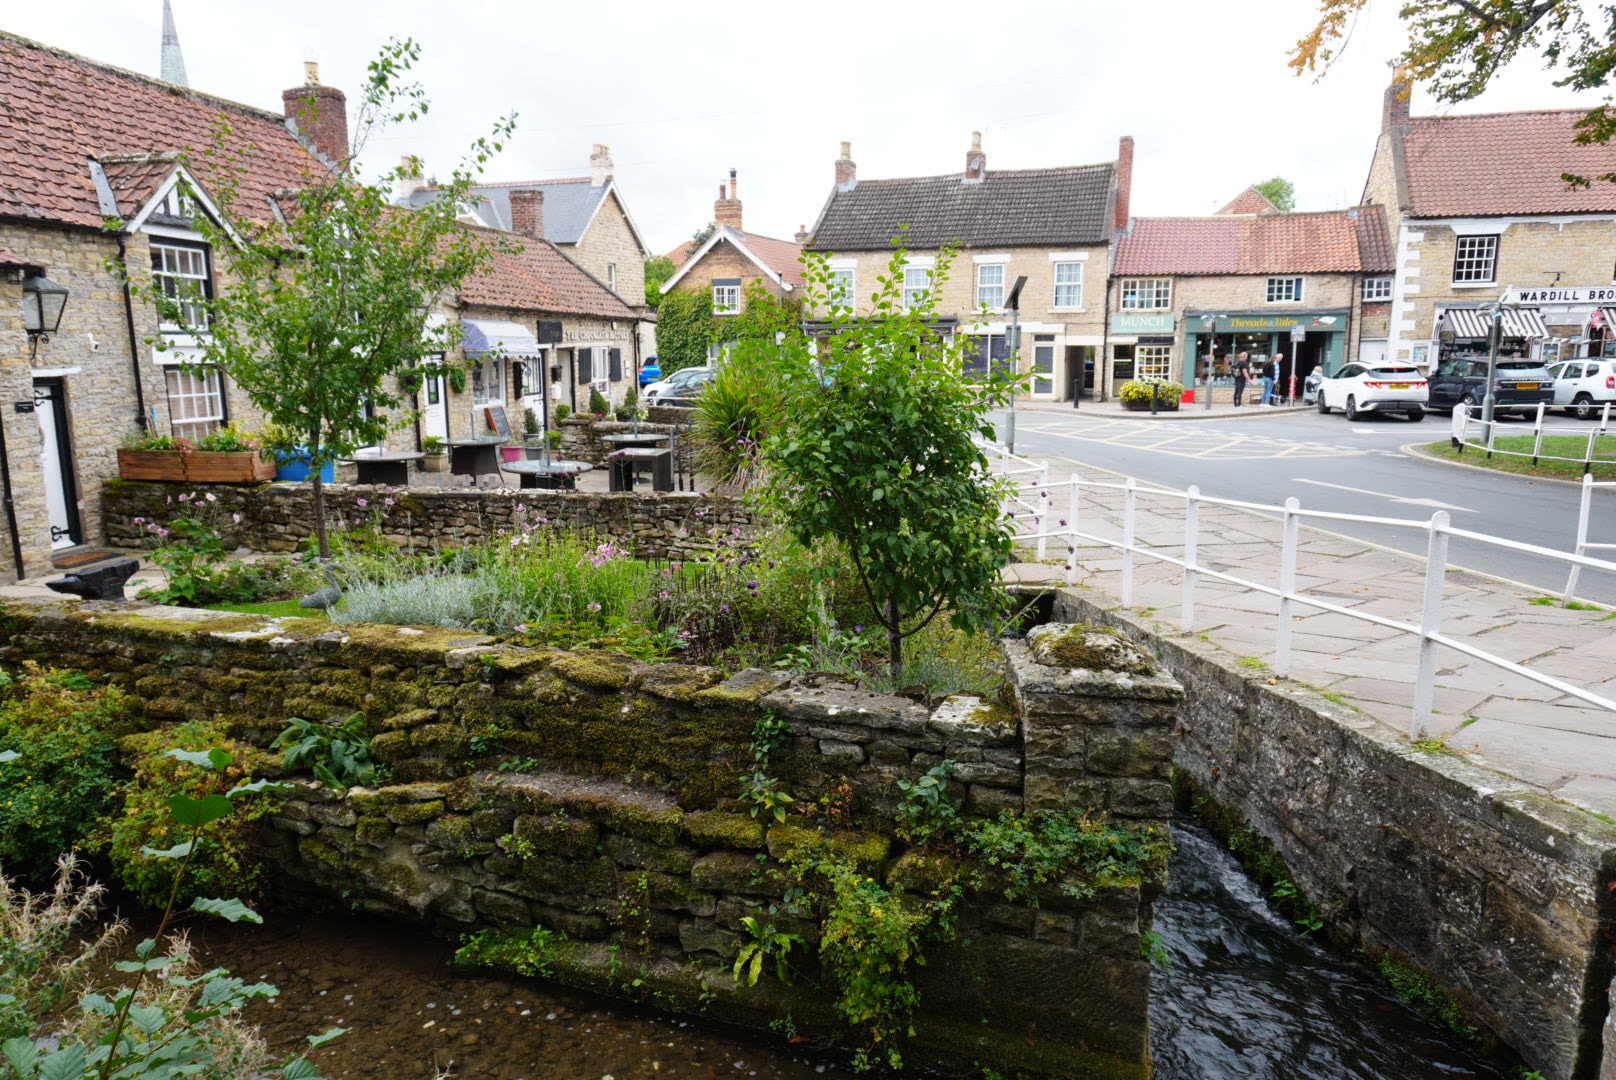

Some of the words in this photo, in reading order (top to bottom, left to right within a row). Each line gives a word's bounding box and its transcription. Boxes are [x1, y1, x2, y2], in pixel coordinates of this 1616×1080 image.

[1520, 291, 1579, 301] WARDILL
[1588, 290, 1616, 300] BRO
[1120, 317, 1165, 327] MUNCH
[1231, 317, 1268, 327] Threads
[1274, 317, 1298, 327] Tales
